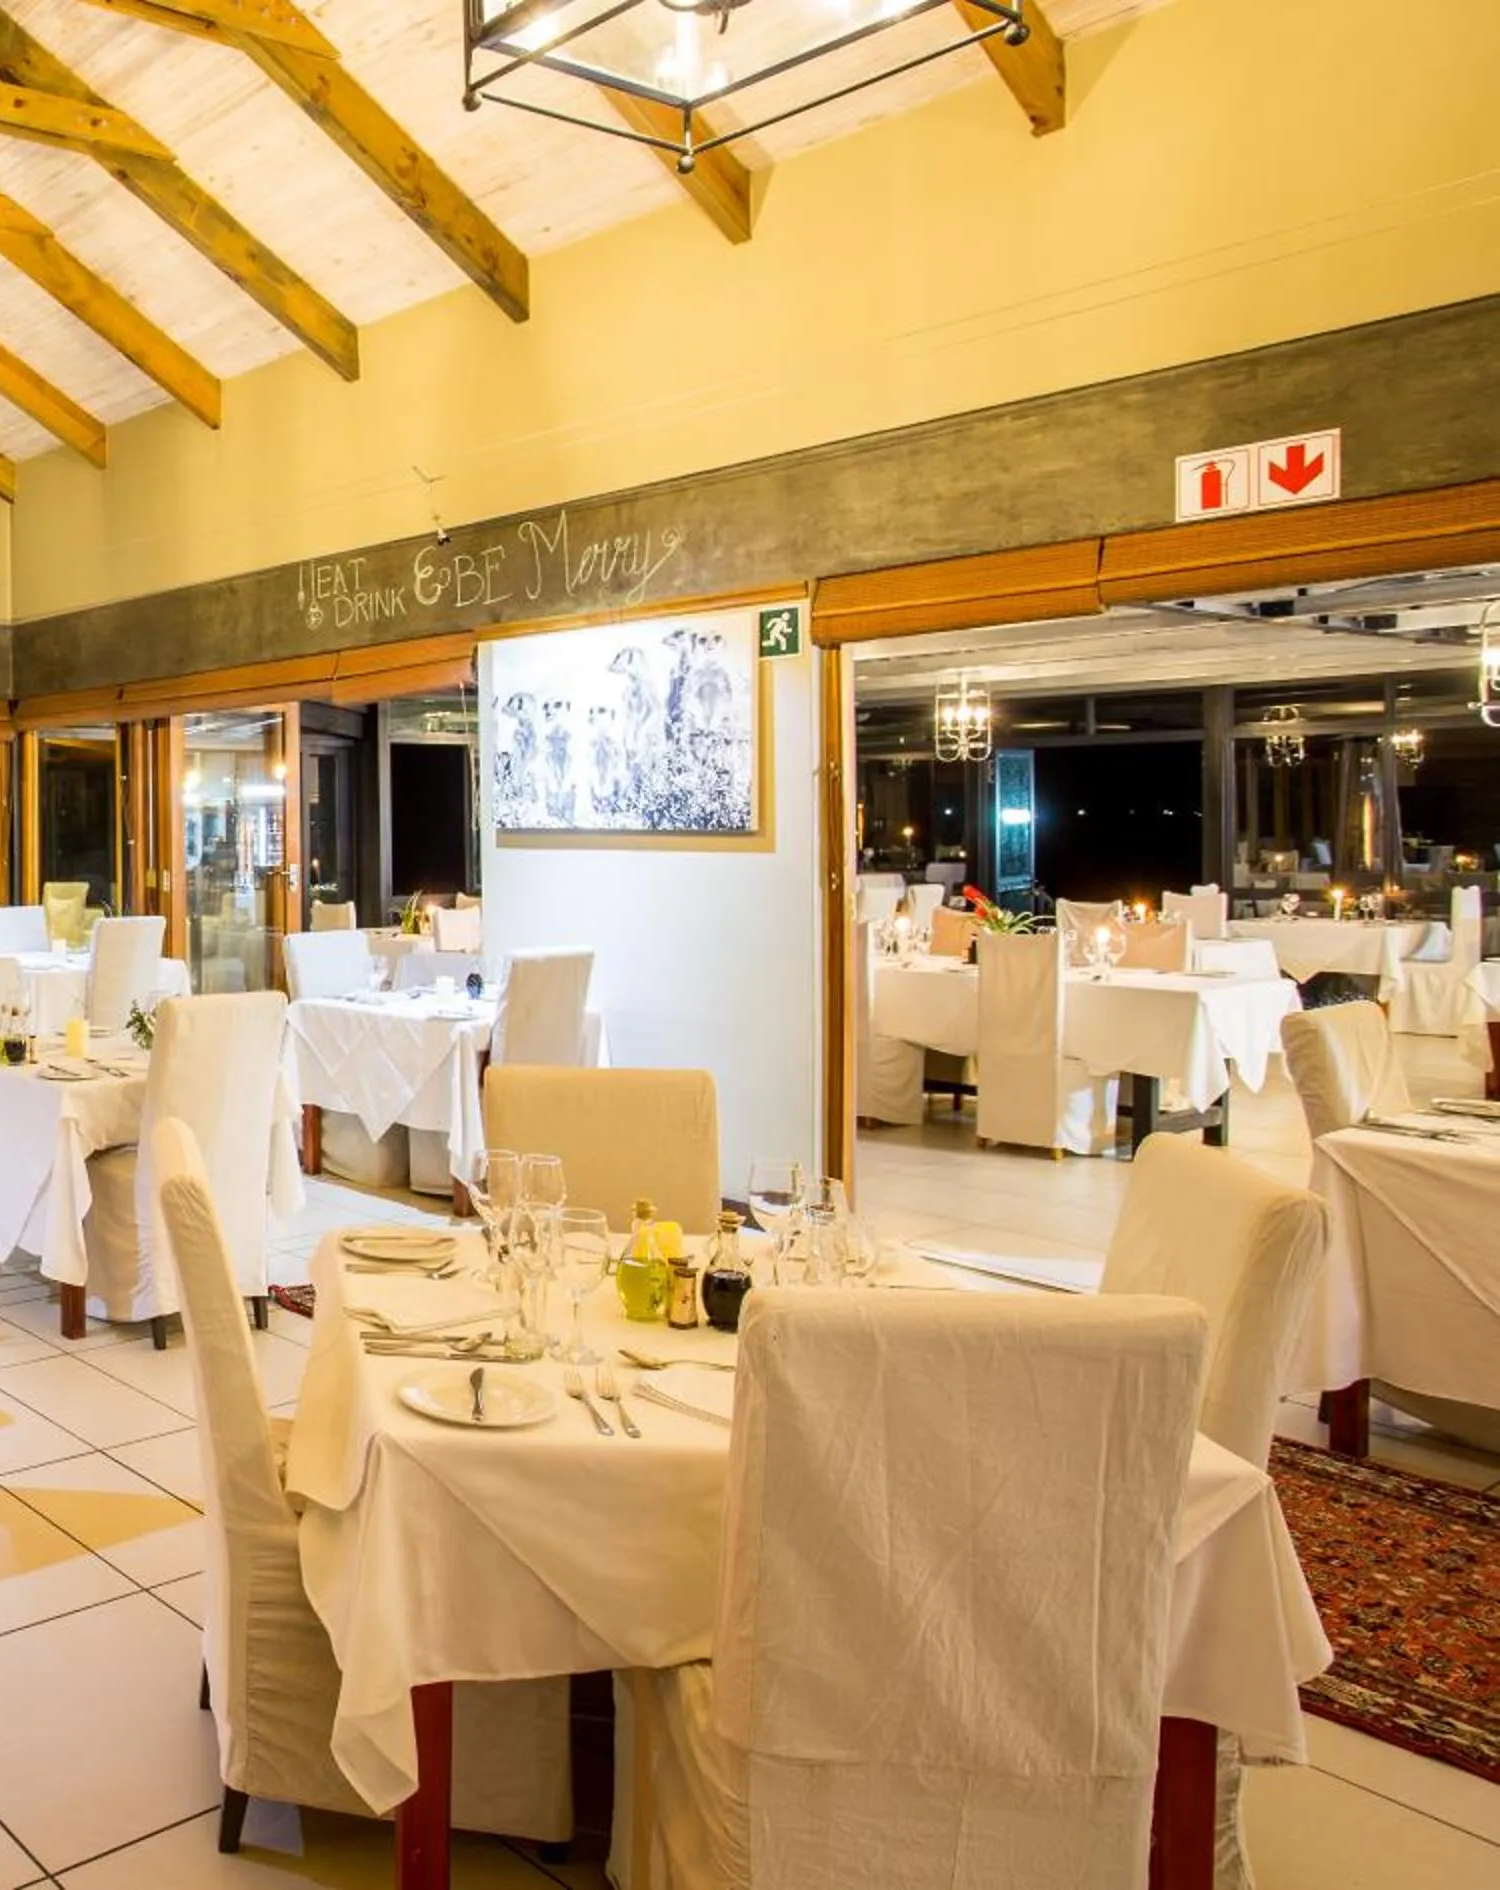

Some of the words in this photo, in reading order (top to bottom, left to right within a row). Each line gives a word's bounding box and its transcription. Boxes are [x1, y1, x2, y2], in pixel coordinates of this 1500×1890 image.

[317, 558, 367, 599] EAT
[413, 545, 452, 606] &
[453, 545, 514, 608] BE
[518, 509, 685, 608] Merry
[334, 588, 407, 628] DRINK
